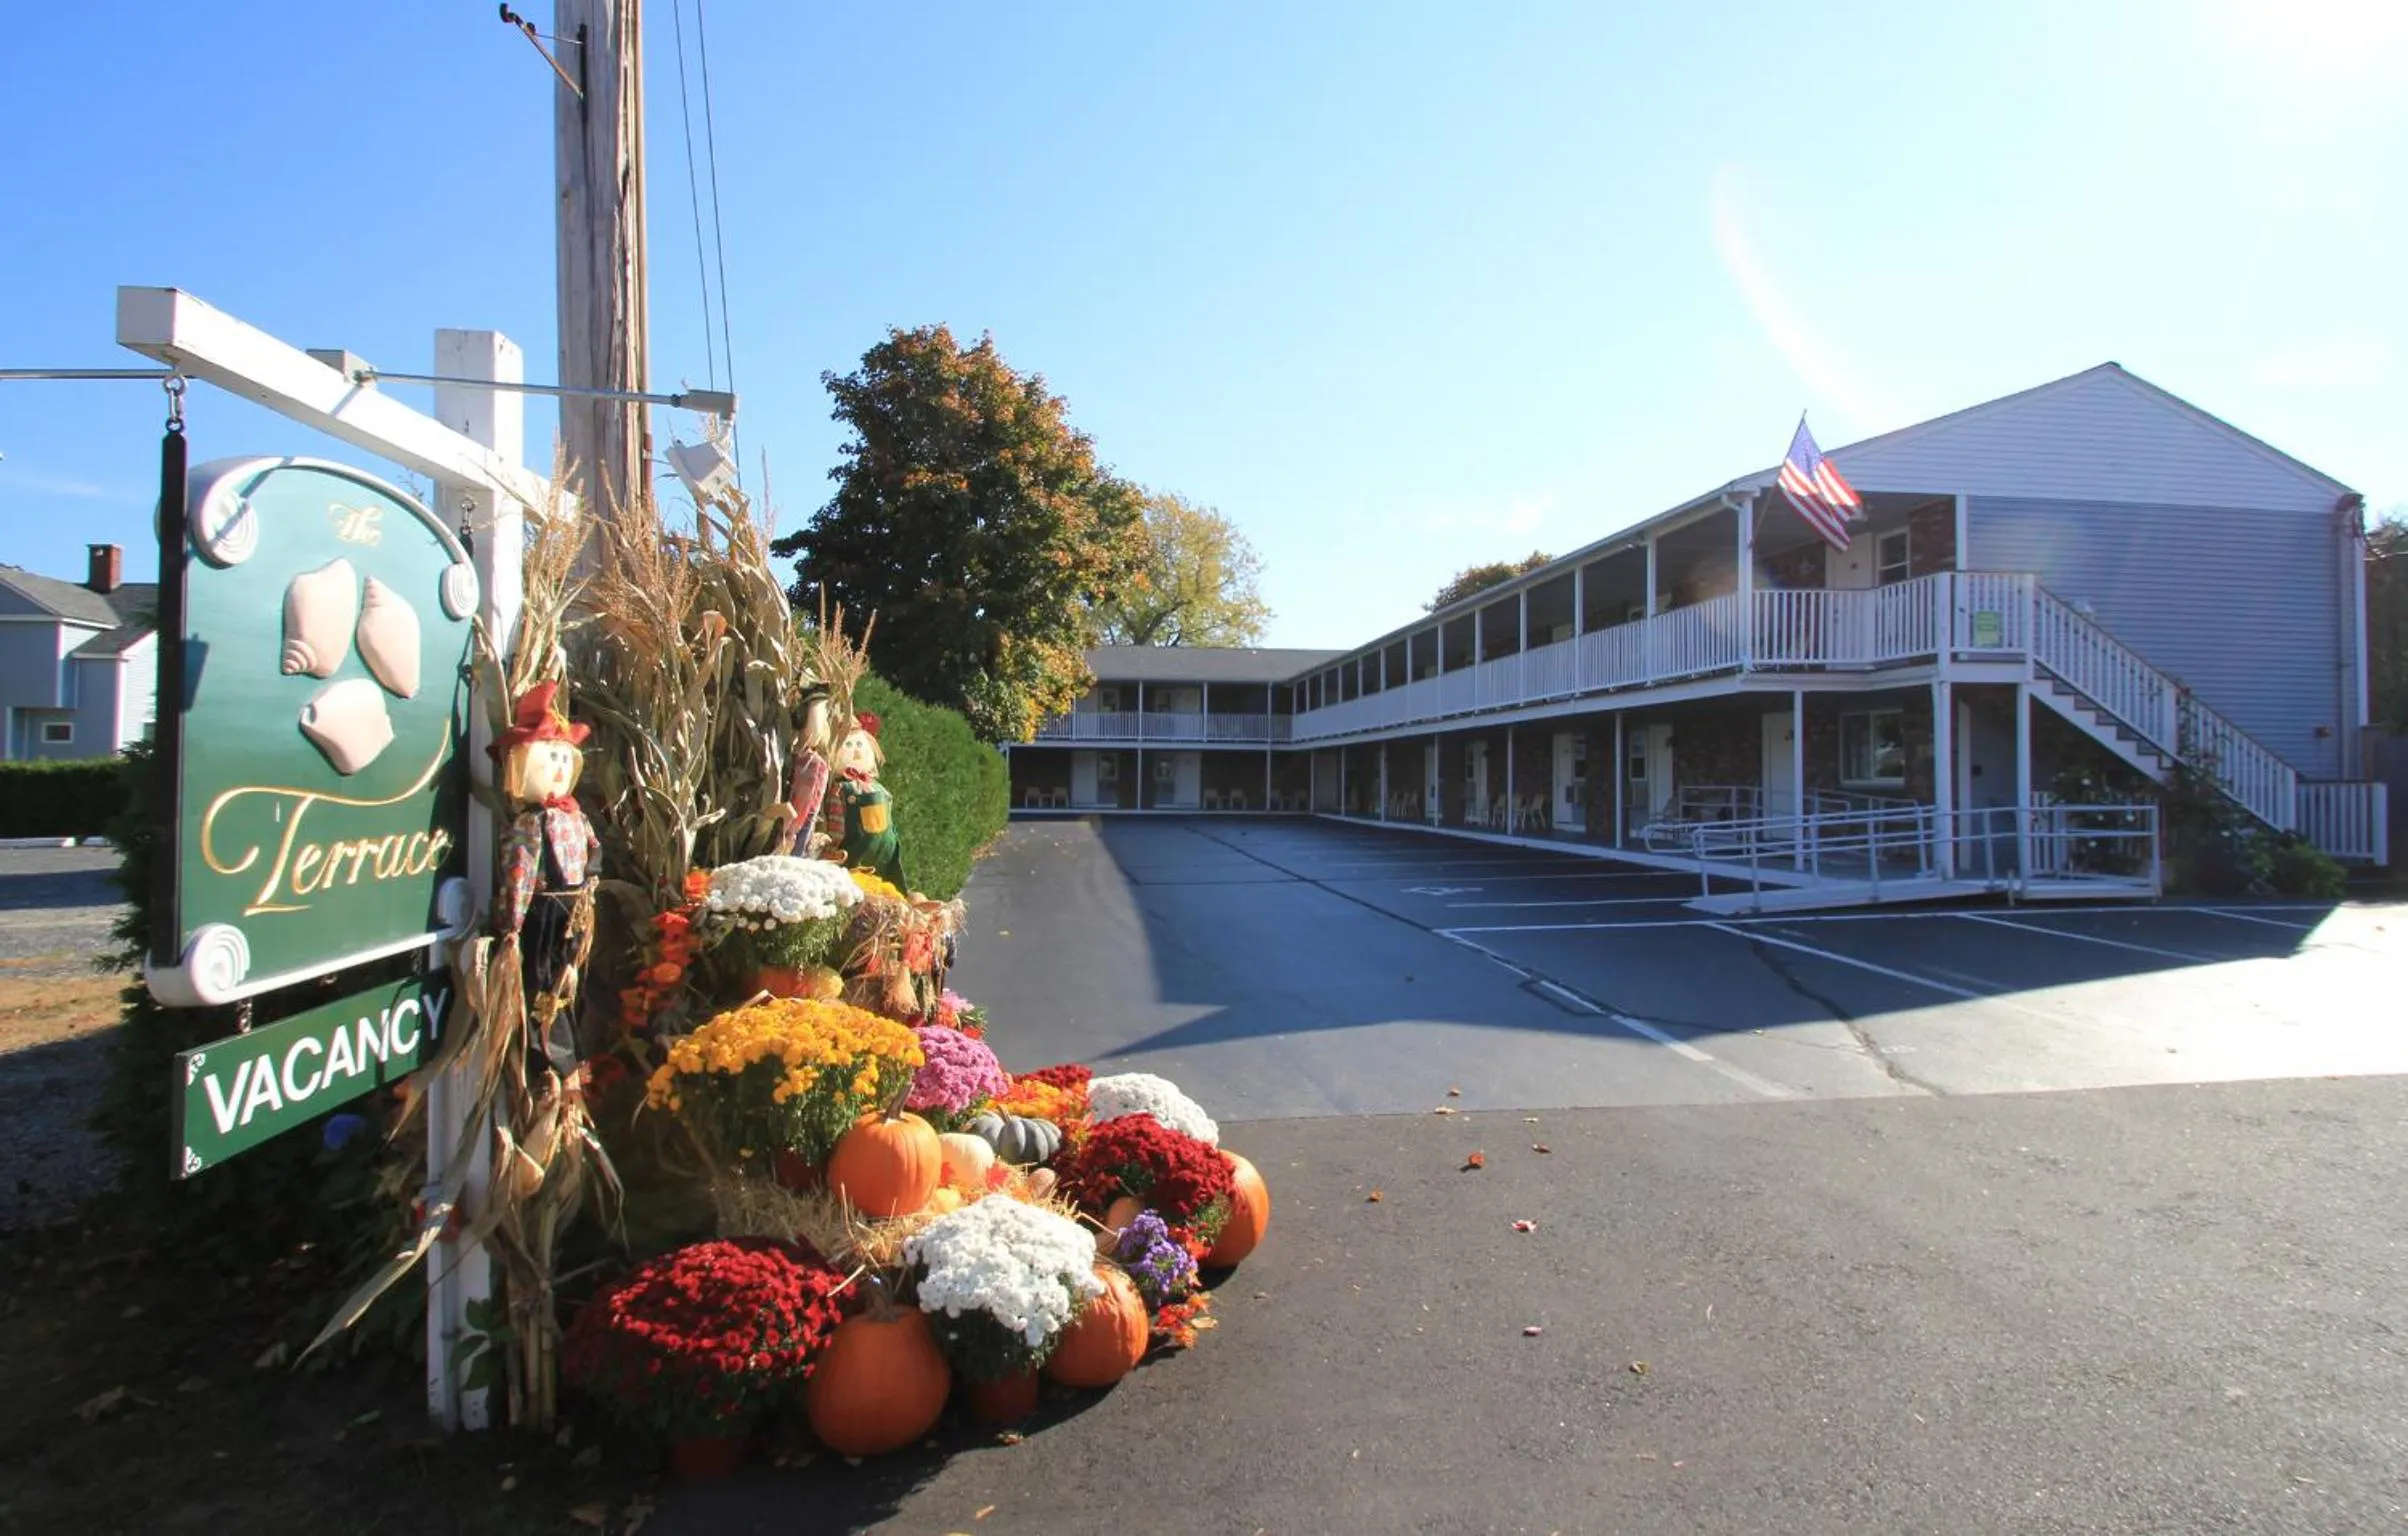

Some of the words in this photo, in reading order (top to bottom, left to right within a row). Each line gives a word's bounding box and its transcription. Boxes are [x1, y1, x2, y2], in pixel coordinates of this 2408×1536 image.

[326, 502, 382, 547] The
[201, 718, 453, 917] Terrace
[204, 988, 449, 1134] VACANCY
